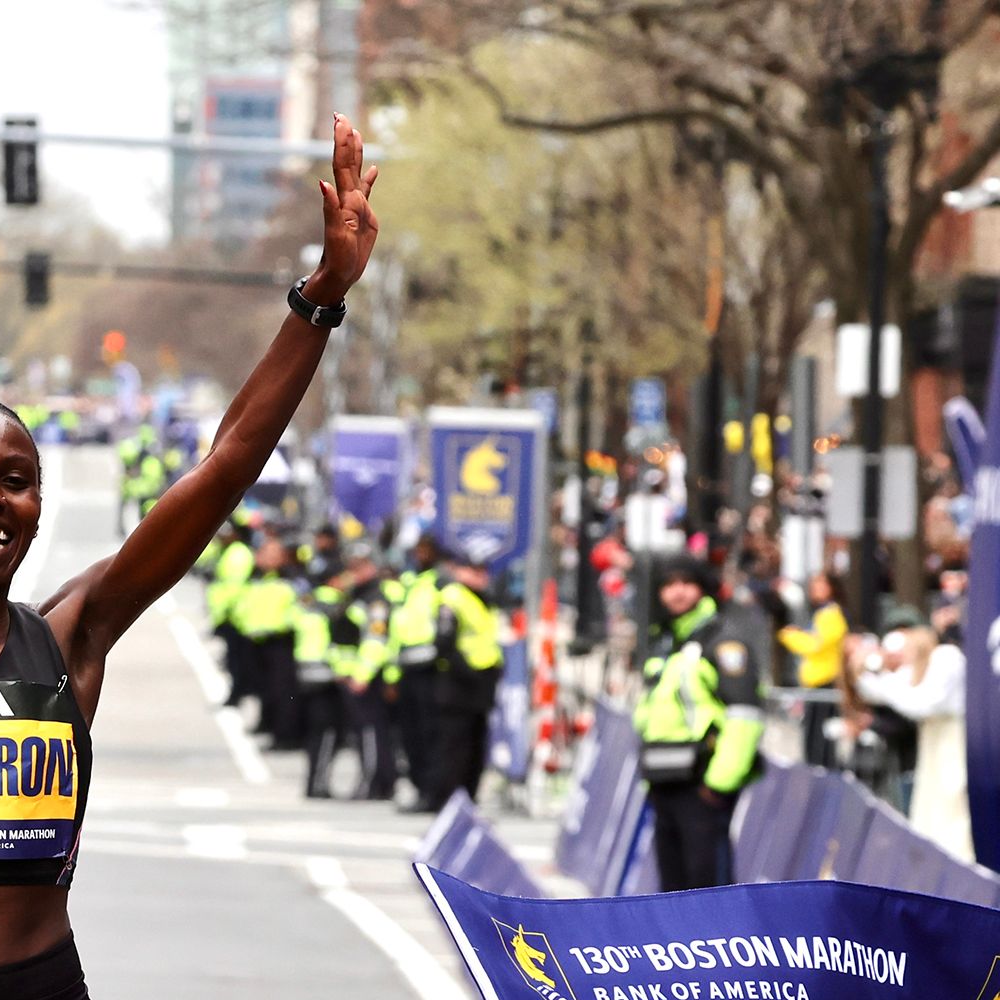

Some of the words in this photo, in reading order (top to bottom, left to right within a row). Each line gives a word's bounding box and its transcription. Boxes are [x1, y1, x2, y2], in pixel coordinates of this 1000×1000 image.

[9, 828, 56, 840] MARATHON
[569, 945, 642, 975] 130TH
[642, 935, 781, 972] BOSTON
[778, 936, 907, 987] MARATHON
[671, 981, 702, 1000] OF
